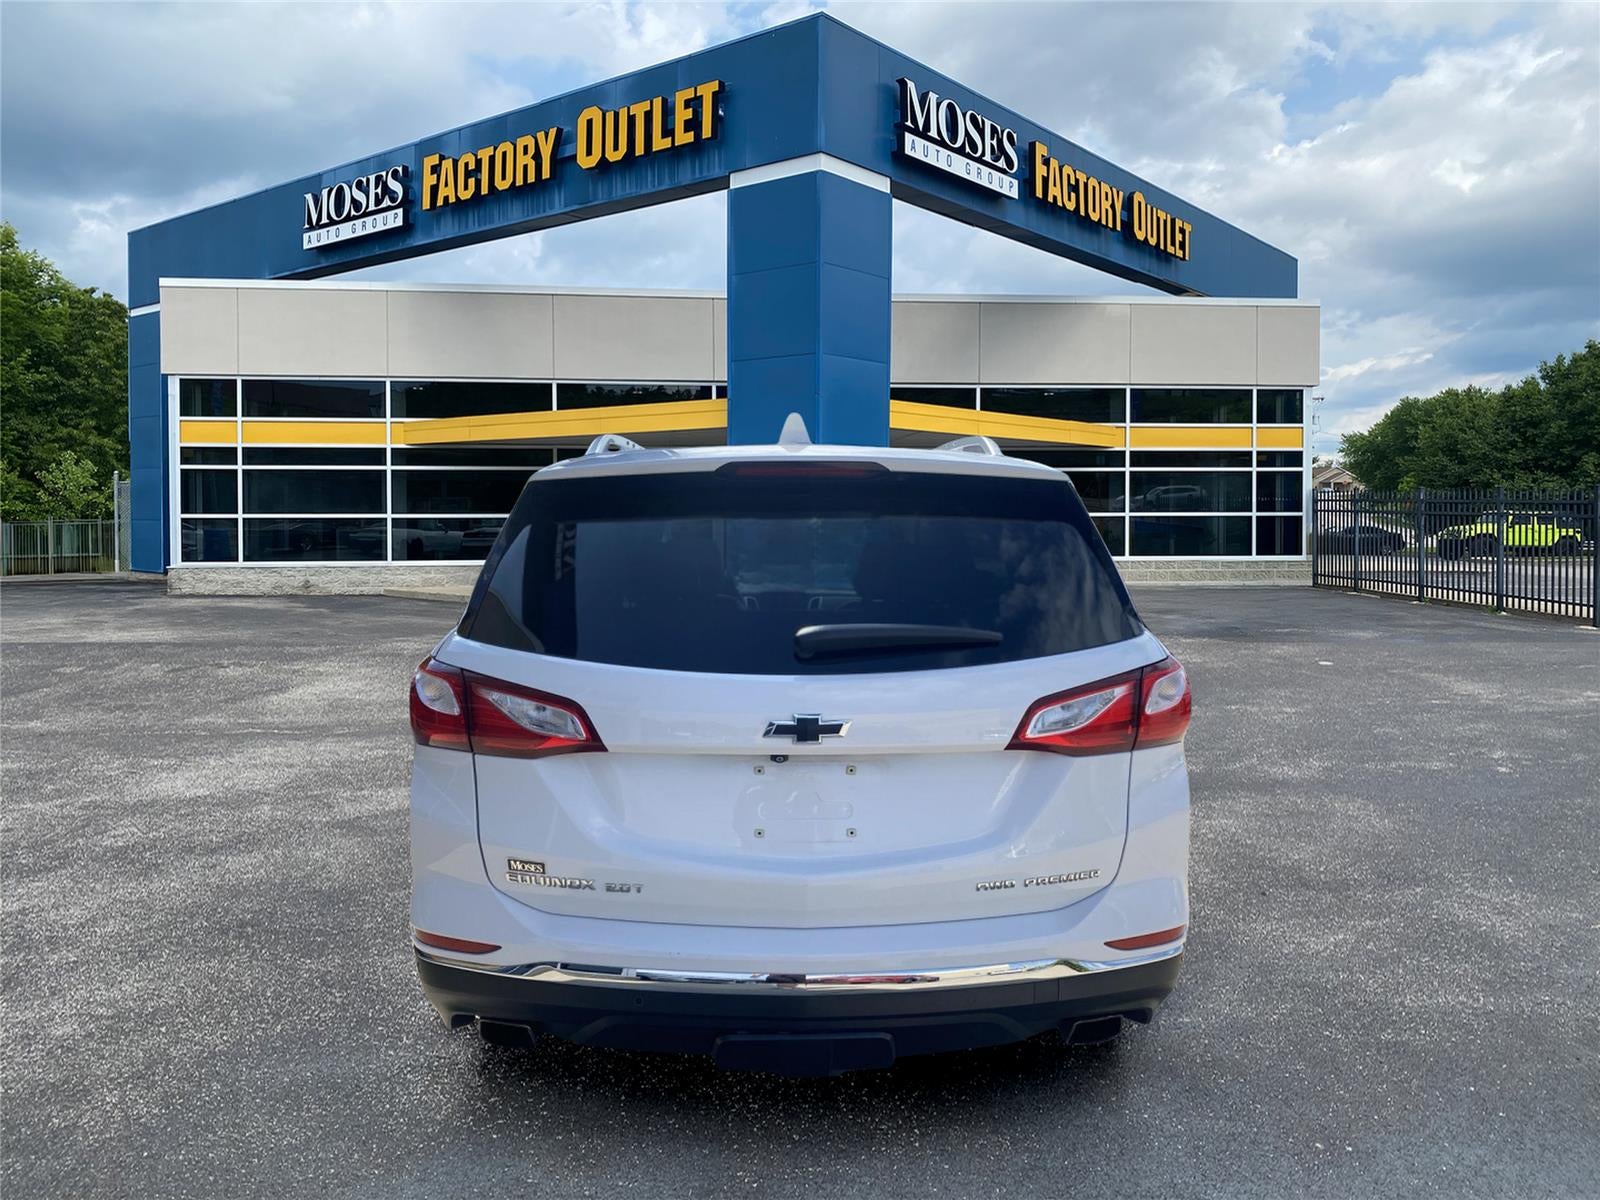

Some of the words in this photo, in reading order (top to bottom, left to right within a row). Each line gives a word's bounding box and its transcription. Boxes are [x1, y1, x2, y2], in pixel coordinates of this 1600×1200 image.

[422, 126, 559, 210] FACTORY
[576, 79, 720, 170] OUTLET
[904, 77, 1018, 174] MOSES
[909, 138, 953, 168] AUTO
[965, 160, 1015, 193] GROUP
[303, 166, 404, 229] MOSES
[1035, 140, 1124, 232] FACTORY
[1132, 190, 1193, 261] OUTLET
[306, 226, 341, 247] AUTO
[350, 212, 400, 235] GROUP
[506, 872, 596, 891] EQUINOX
[509, 860, 544, 873] MOSES
[976, 879, 1016, 892] AWD
[1023, 868, 1100, 888] PREMIER
